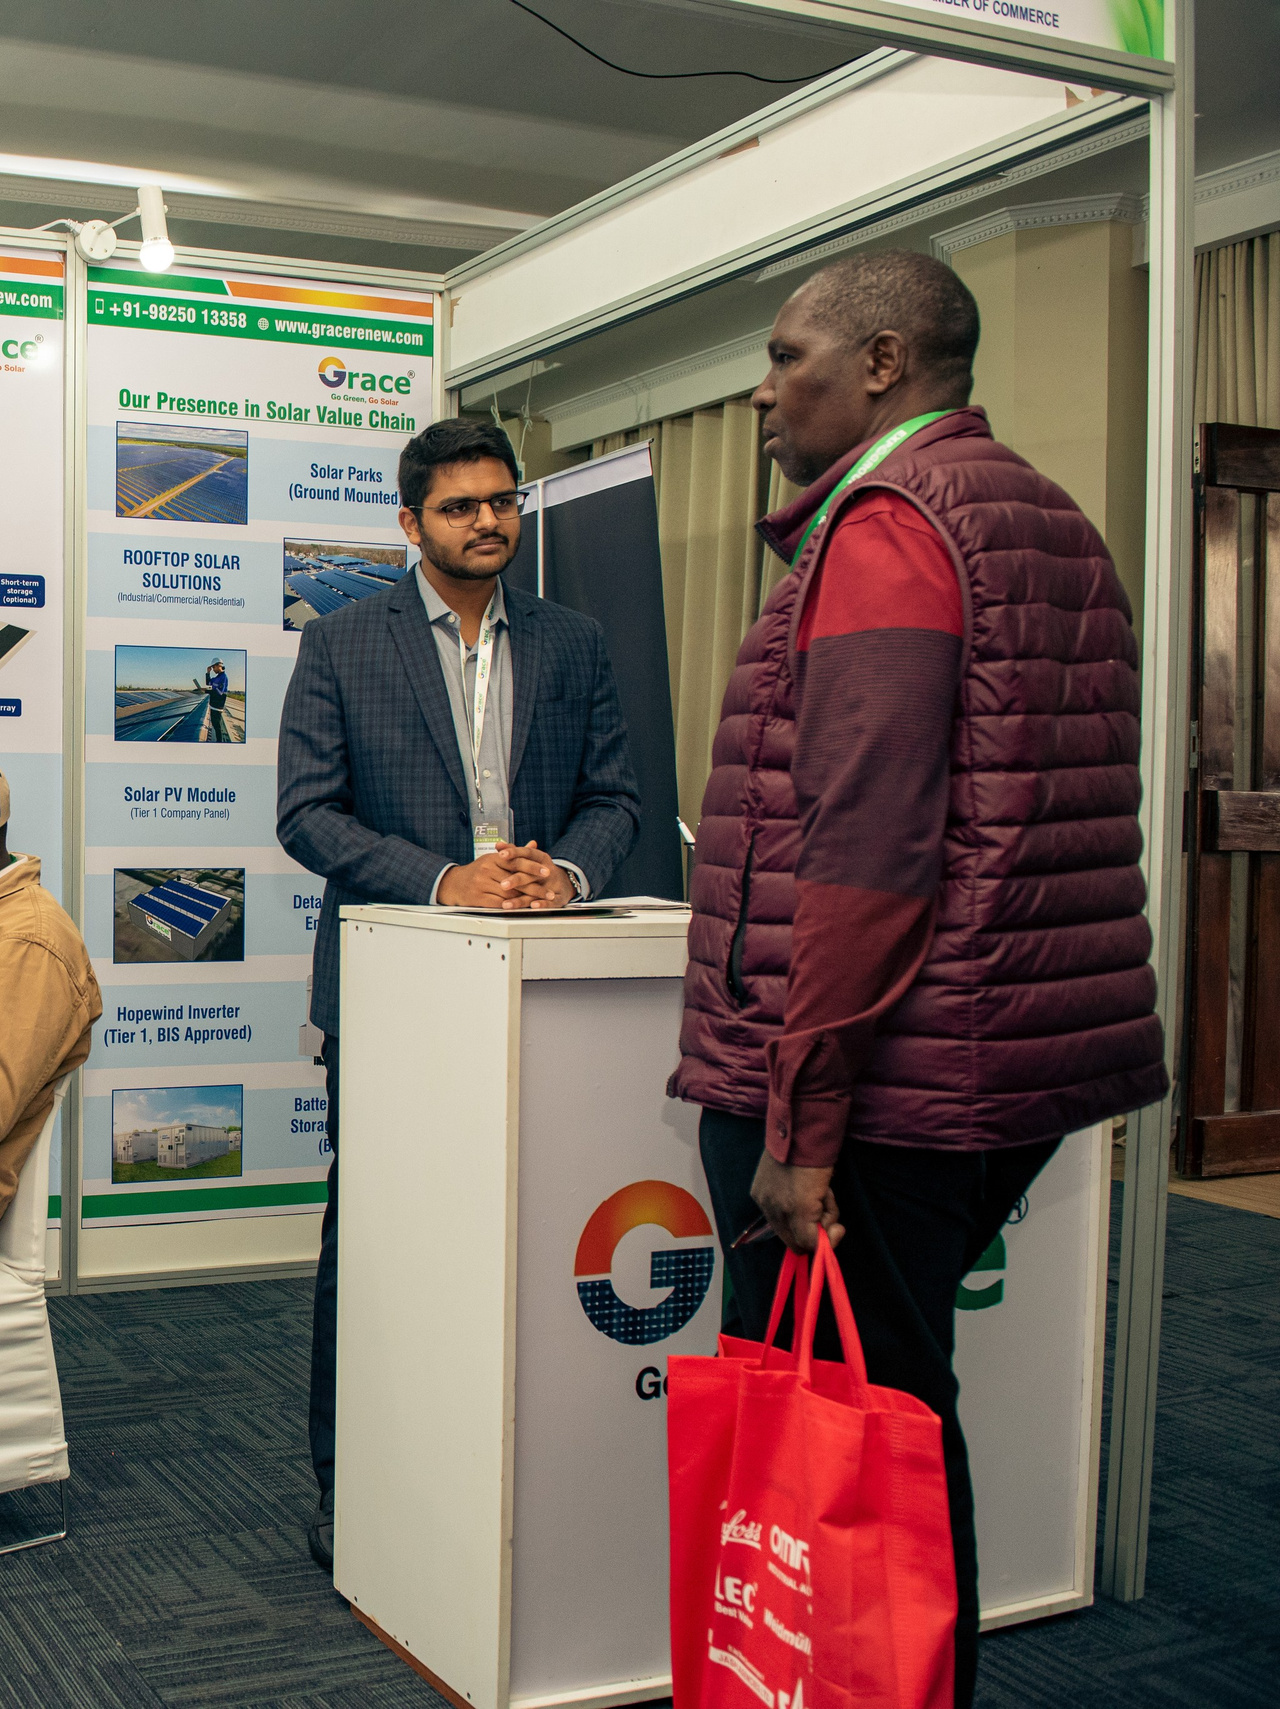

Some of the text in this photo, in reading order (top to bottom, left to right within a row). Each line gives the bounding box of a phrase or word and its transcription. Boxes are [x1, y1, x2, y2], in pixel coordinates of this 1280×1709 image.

[973, 0, 989, 13] OF
[992, 0, 1060, 28] COMMERCE
[109, 302, 423, 346] +91-98250 13358 www.gracerenew.com
[4, 364, 25, 373] Solar
[119, 388, 416, 432] Our Presence in Solar Value Chain
[310, 463, 382, 483] Solar Parks
[288, 483, 340, 502] (Ground
[123, 550, 240, 570] ROOFTOP SOLAR
[1, 579, 39, 587] Short-term
[142, 572, 221, 591] SOLUTIONS
[3, 595, 37, 605] (optional)
[7, 587, 33, 596] storage
[118, 592, 245, 608] (Industrial/Commercial/Residential)
[124, 786, 236, 803] Solar PV Module
[130, 807, 230, 820] (Tier Company Panel)
[117, 1005, 240, 1023] Hopewind Inverter
[104, 1025, 252, 1047] (Tier 1, BIS Approved)
